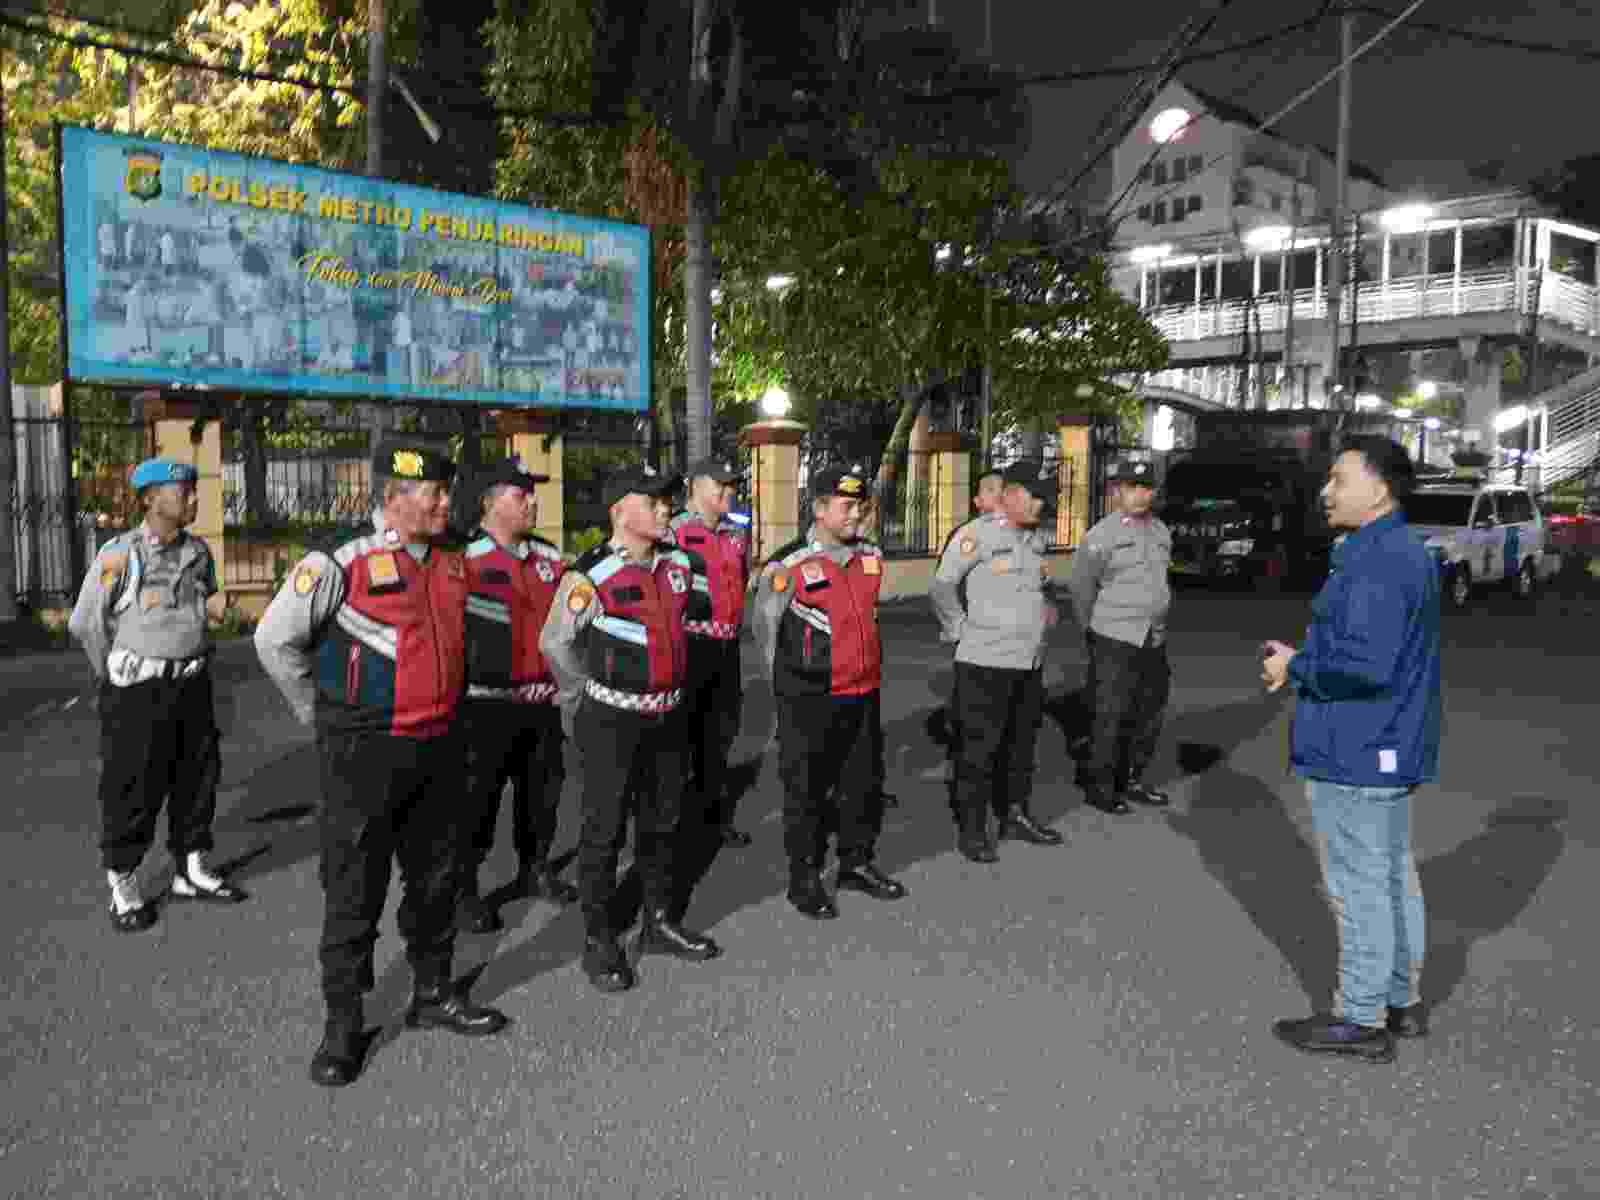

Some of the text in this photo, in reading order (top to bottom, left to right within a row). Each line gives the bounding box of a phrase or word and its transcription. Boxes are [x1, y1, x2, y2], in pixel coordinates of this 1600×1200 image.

[188, 173, 585, 257] POLSEK METRO PENJARINGAN
